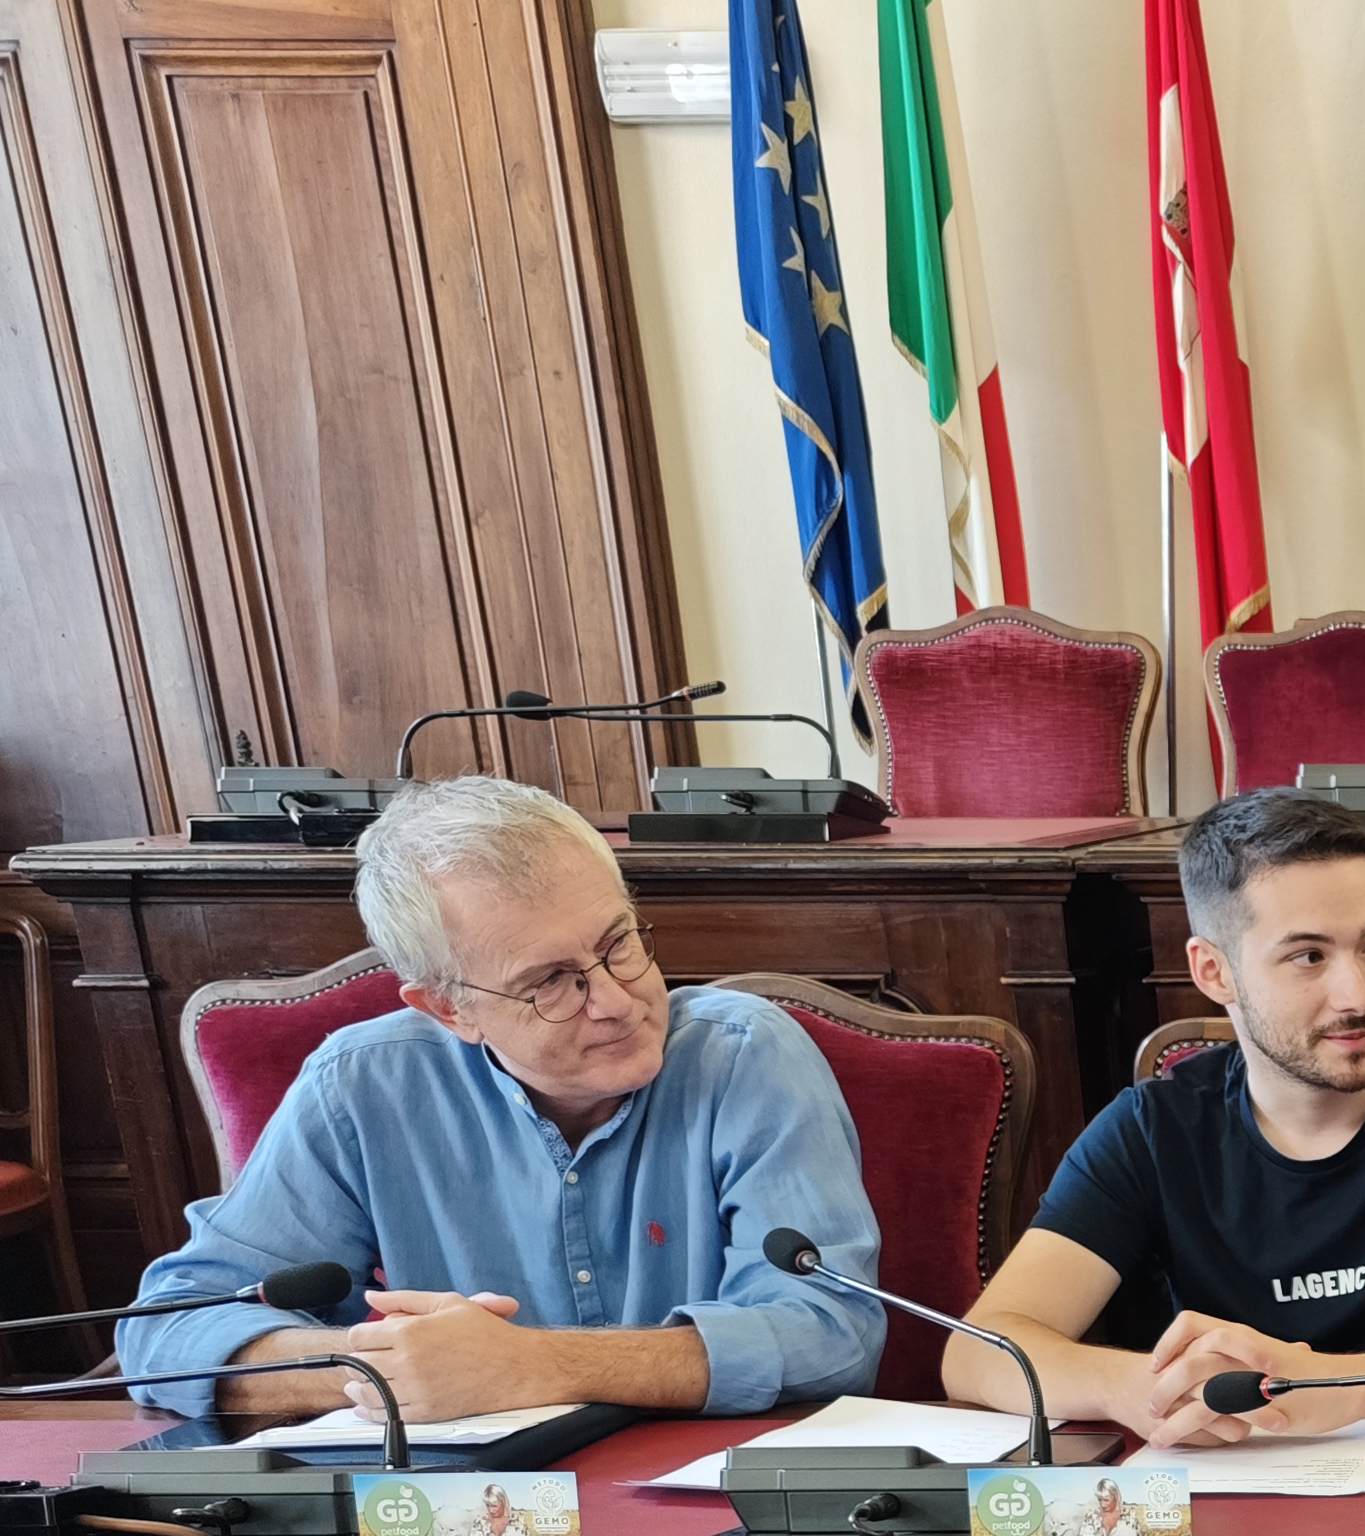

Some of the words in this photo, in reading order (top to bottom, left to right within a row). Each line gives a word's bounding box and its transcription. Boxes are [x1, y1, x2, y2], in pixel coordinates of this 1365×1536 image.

[1146, 1511, 1180, 1520] GEMO
[536, 1517, 569, 1525] GEMO
[992, 1521, 1031, 1531] petfood
